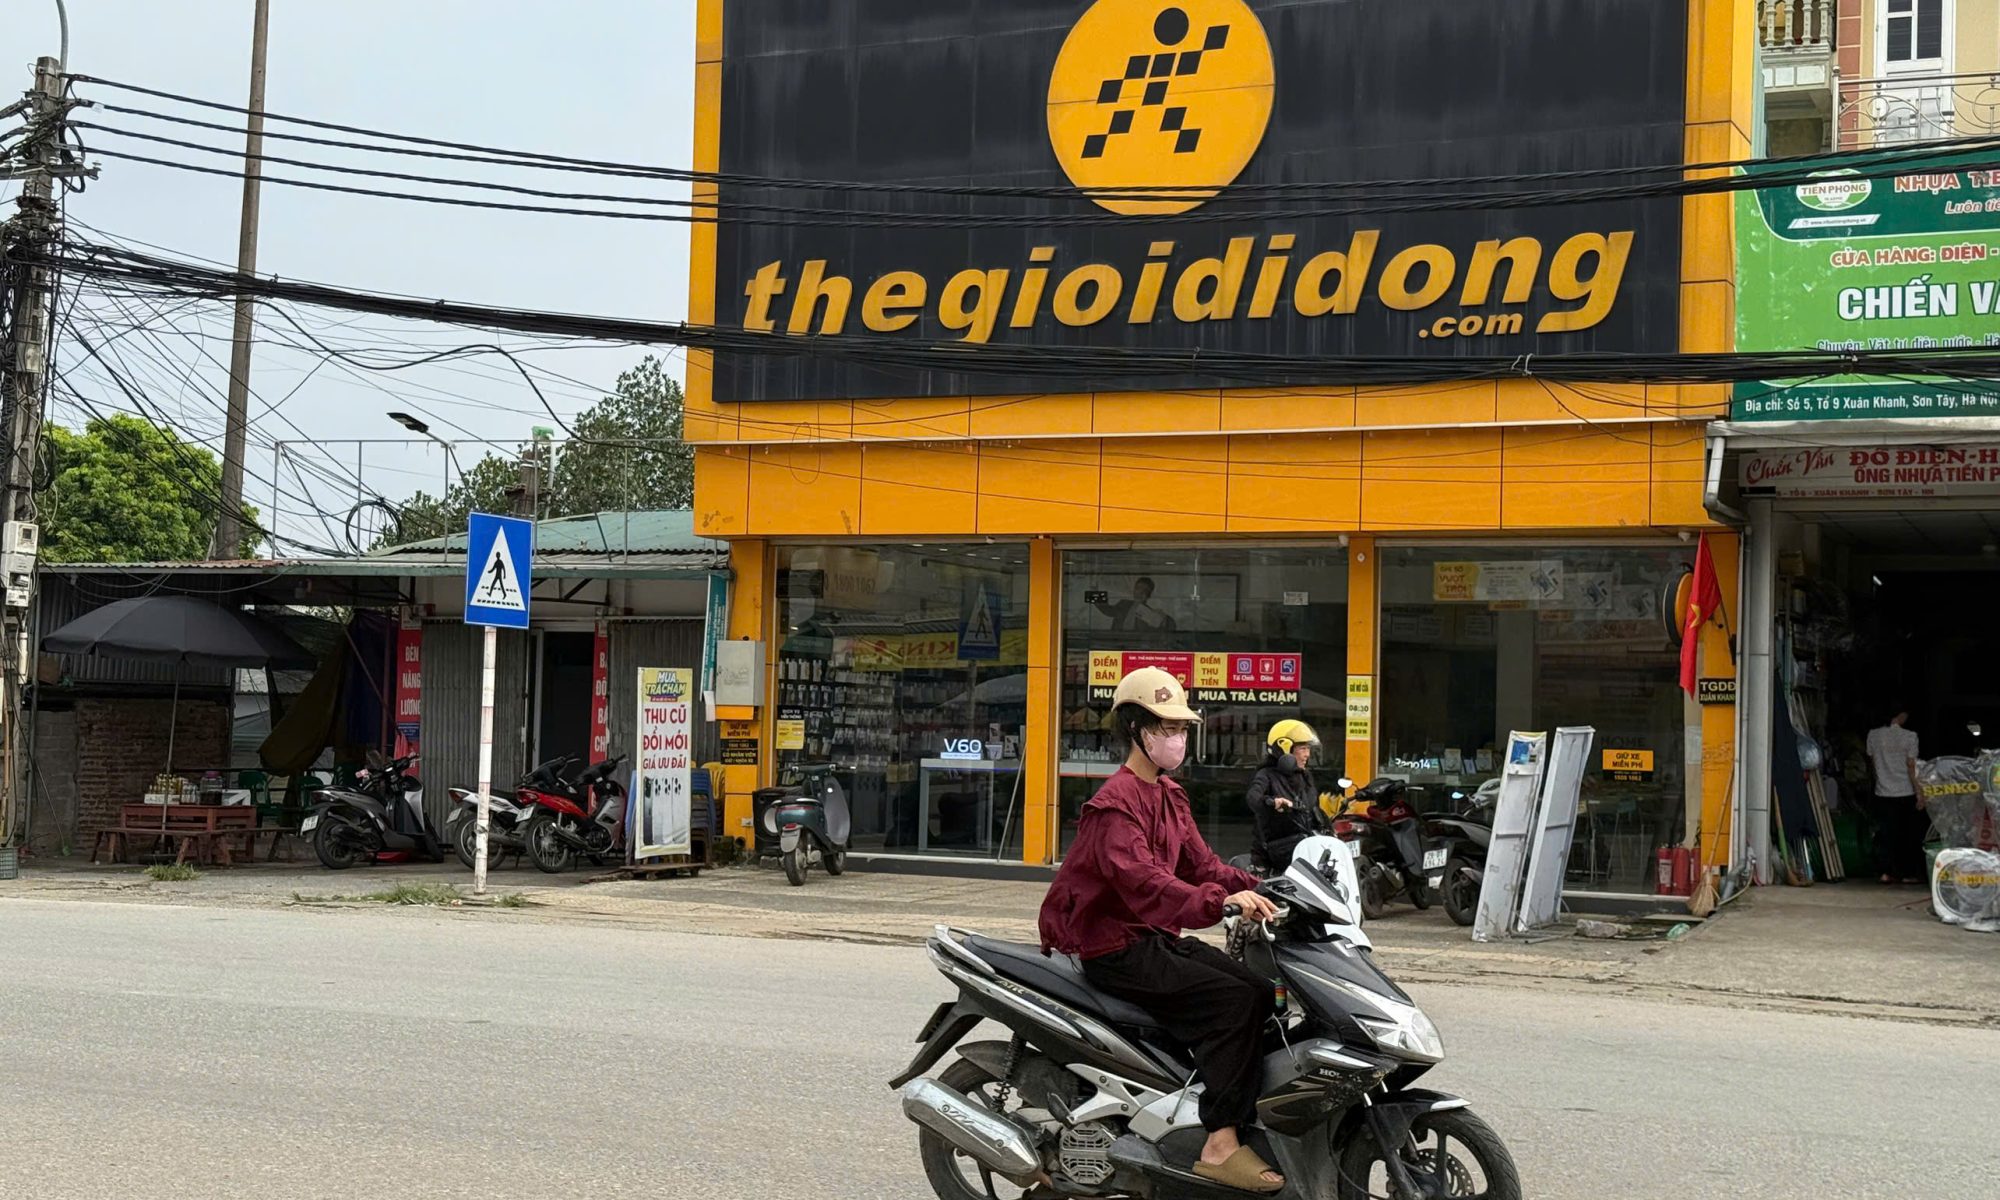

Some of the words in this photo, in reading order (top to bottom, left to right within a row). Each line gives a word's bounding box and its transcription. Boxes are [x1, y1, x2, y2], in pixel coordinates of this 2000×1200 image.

[1828, 184, 1867, 194] PHONG
[1945, 200, 1982, 214] Luôn
[1831, 247, 1872, 268] CỬA
[1875, 245, 1936, 265] HÀNG:
[1940, 241, 1987, 264] ĐIỆN
[743, 230, 1635, 344] thegioididong
[1838, 274, 1959, 321] CHIẾN
[1418, 312, 1523, 338] .com
[1745, 399, 1762, 414] Địa
[1786, 396, 1801, 410] Số
[1803, 398, 1814, 412] 5,
[1816, 395, 1831, 409] Tổ
[1832, 397, 1840, 409] 9
[1843, 395, 1870, 409] Xuân
[1873, 395, 1909, 409] Khanh,
[1912, 394, 1933, 407] Sơn
[1936, 394, 1958, 409] Tây,
[1961, 393, 1976, 406] Hà
[1854, 465, 1890, 483] ỐNG
[1093, 656, 1118, 666] ĐIỂM
[1200, 655, 1221, 664] ĐIỂM
[1095, 670, 1116, 680] BÁN
[1198, 690, 1227, 701] MUA
[1229, 689, 1256, 702] TRẢ
[1259, 689, 1297, 705] CHẬM
[645, 708, 667, 724] THU
[670, 704, 687, 724] CŨ
[643, 725, 662, 750] ĐỔI
[665, 729, 688, 750] MỚI
[943, 737, 982, 753] V60
[643, 754, 656, 769] GIÁ
[1631, 760, 1643, 768] PHÍ
[1922, 780, 1980, 797] SENKO
